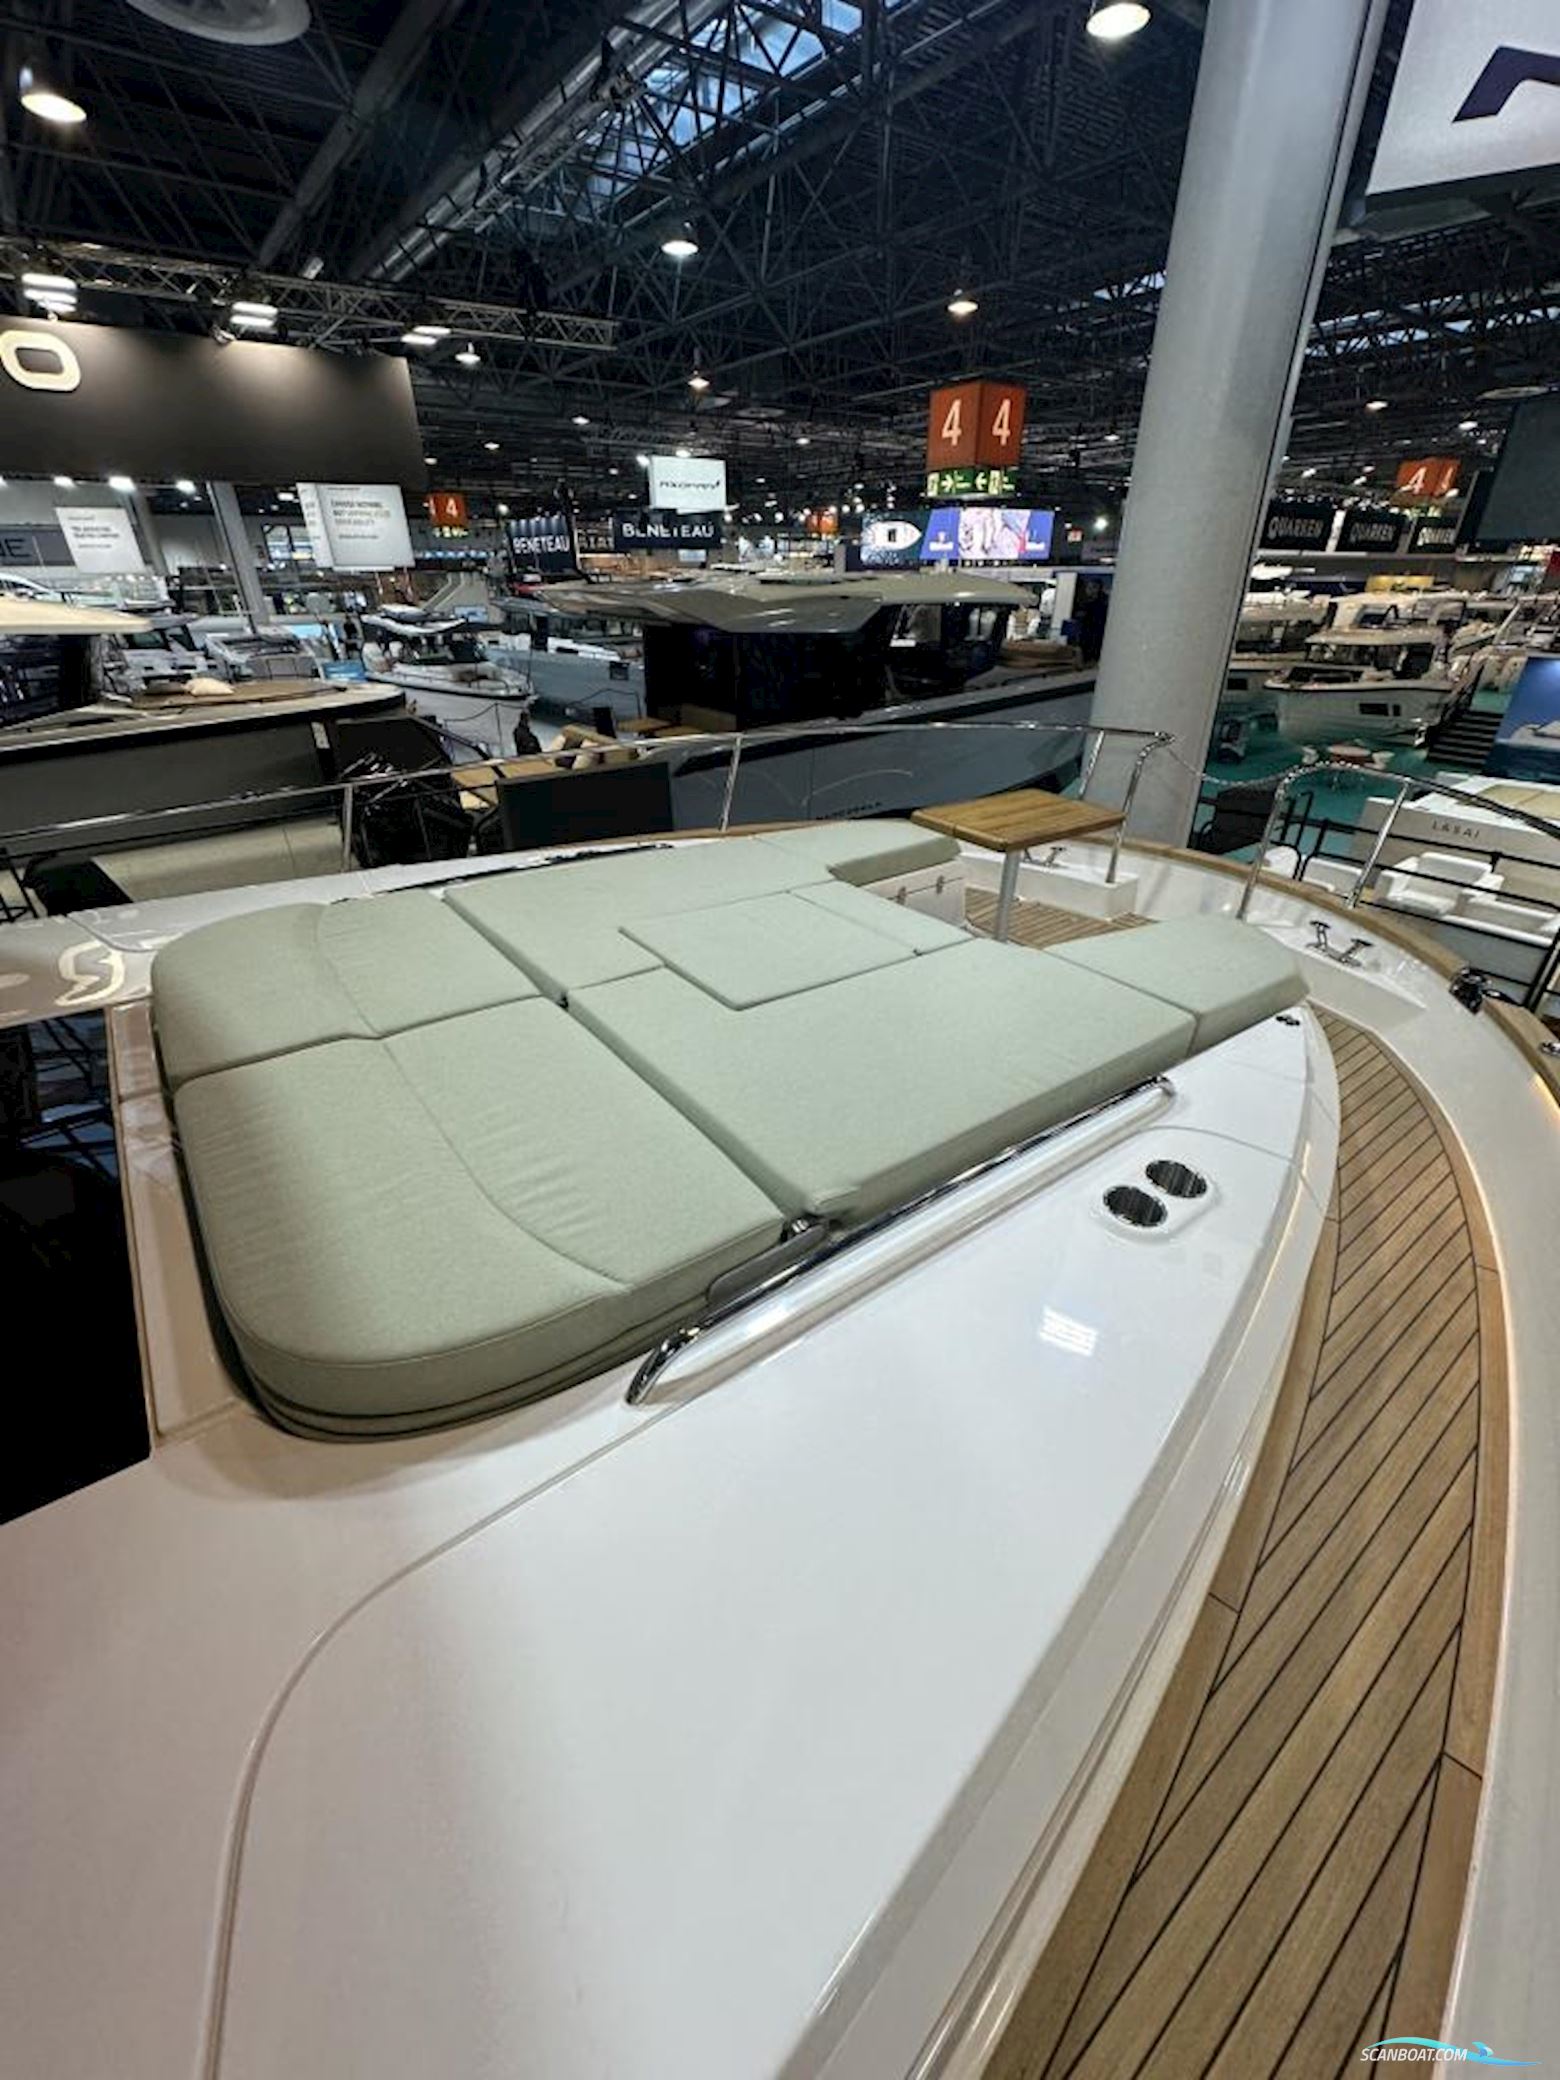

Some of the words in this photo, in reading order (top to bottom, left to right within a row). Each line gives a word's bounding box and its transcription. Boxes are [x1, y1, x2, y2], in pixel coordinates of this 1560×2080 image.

[941, 398, 962, 447] 4
[992, 398, 1011, 446] 4
[1408, 466, 1427, 495] 4
[445, 497, 459, 518] 4
[512, 535, 571, 555] BENETEAU
